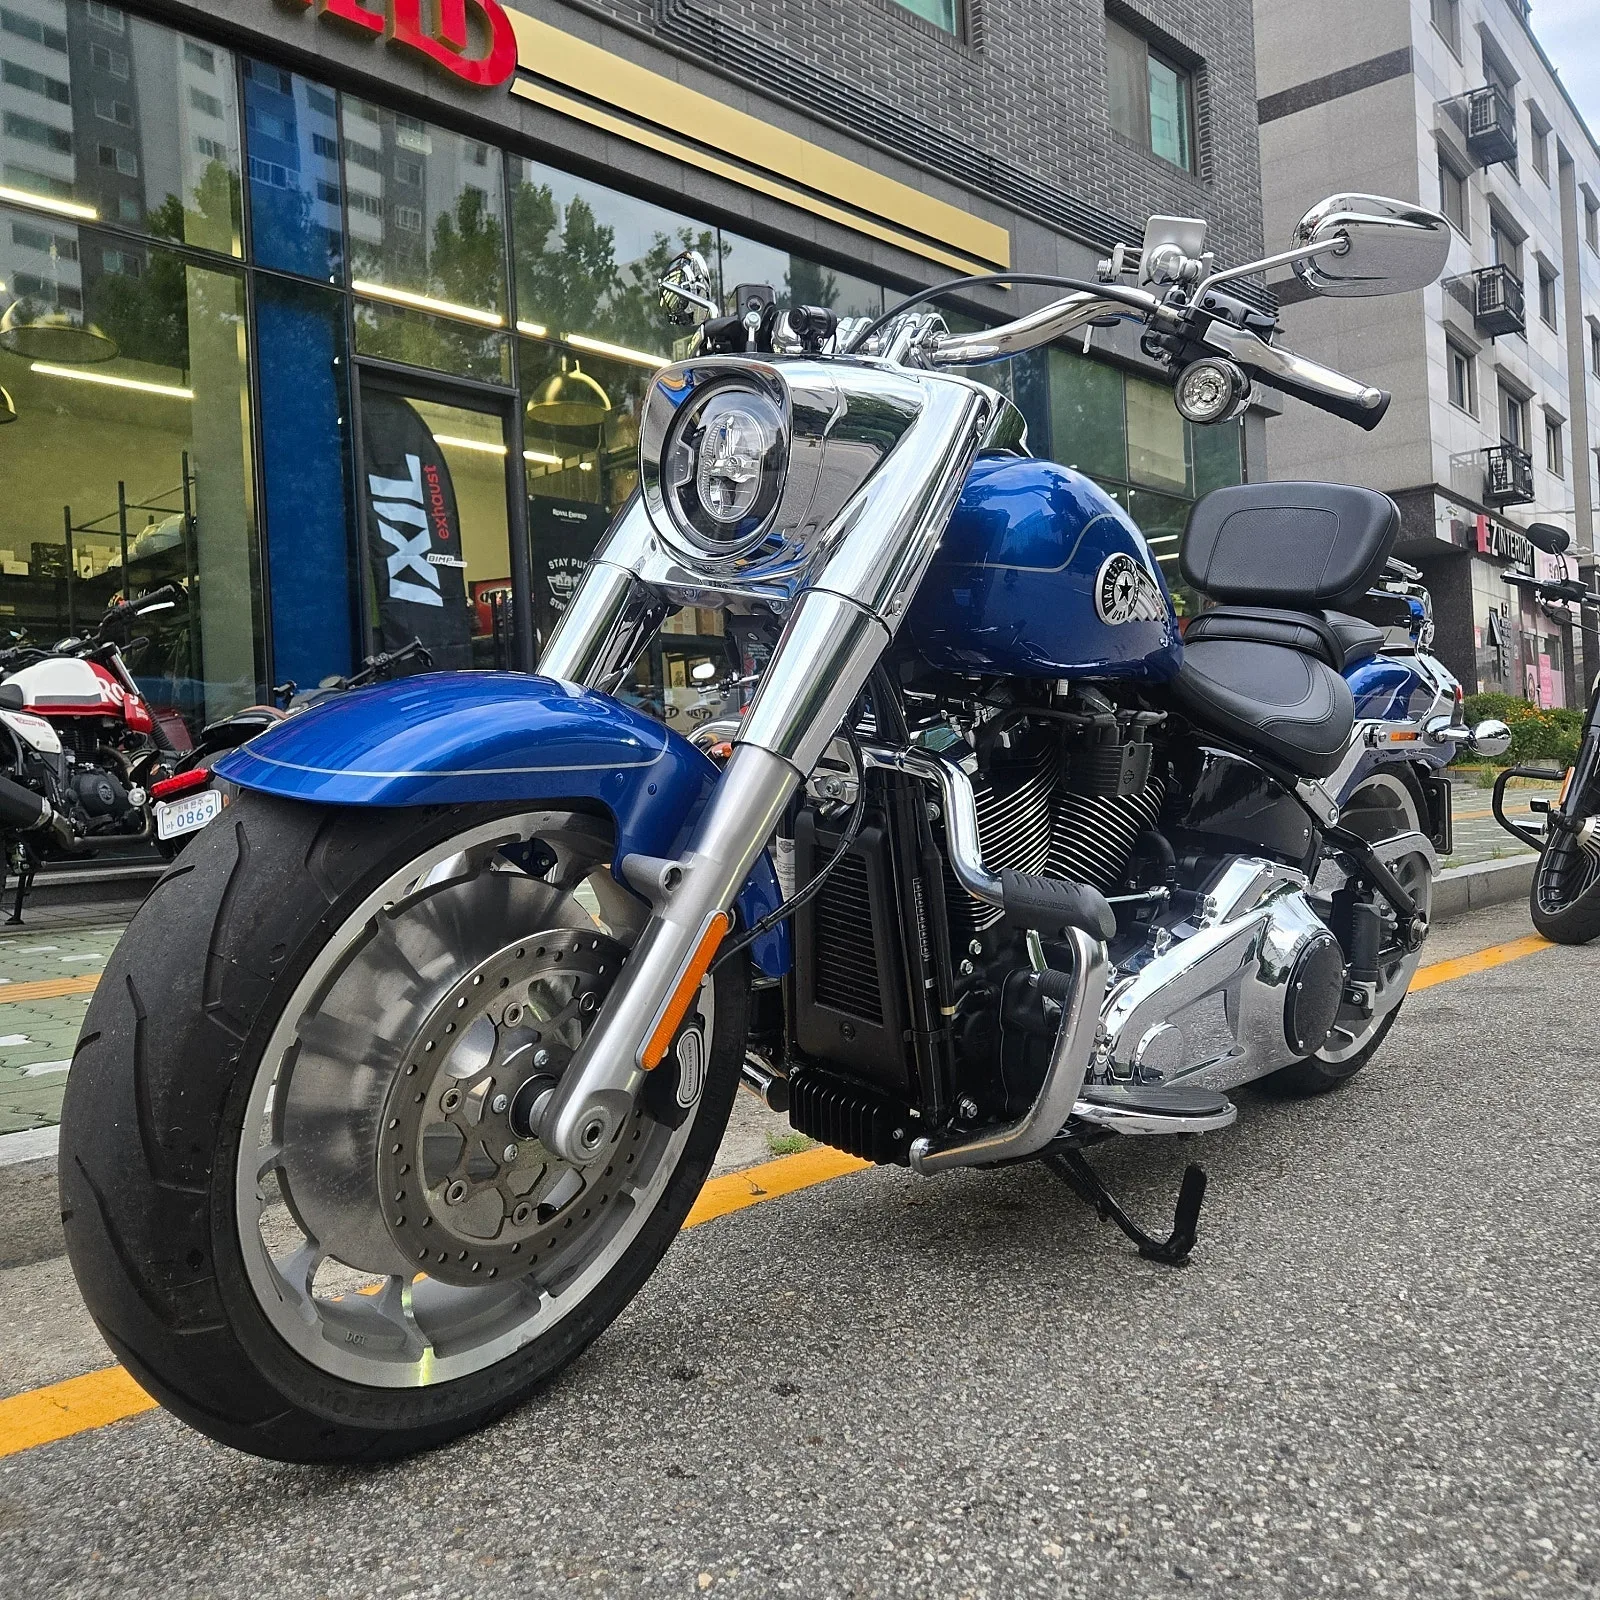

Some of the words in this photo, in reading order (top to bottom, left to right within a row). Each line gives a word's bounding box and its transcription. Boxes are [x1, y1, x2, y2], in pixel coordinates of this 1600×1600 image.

[424, 464, 450, 540] exhaust
[369, 453, 443, 608] IXIL
[1498, 524, 1533, 566] INTERIOR
[548, 558, 568, 570] STAY
[549, 597, 566, 611] STAY
[1111, 609, 1127, 620] USA
[177, 805, 213, 827] 0869
[345, 1331, 366, 1345] DOT
